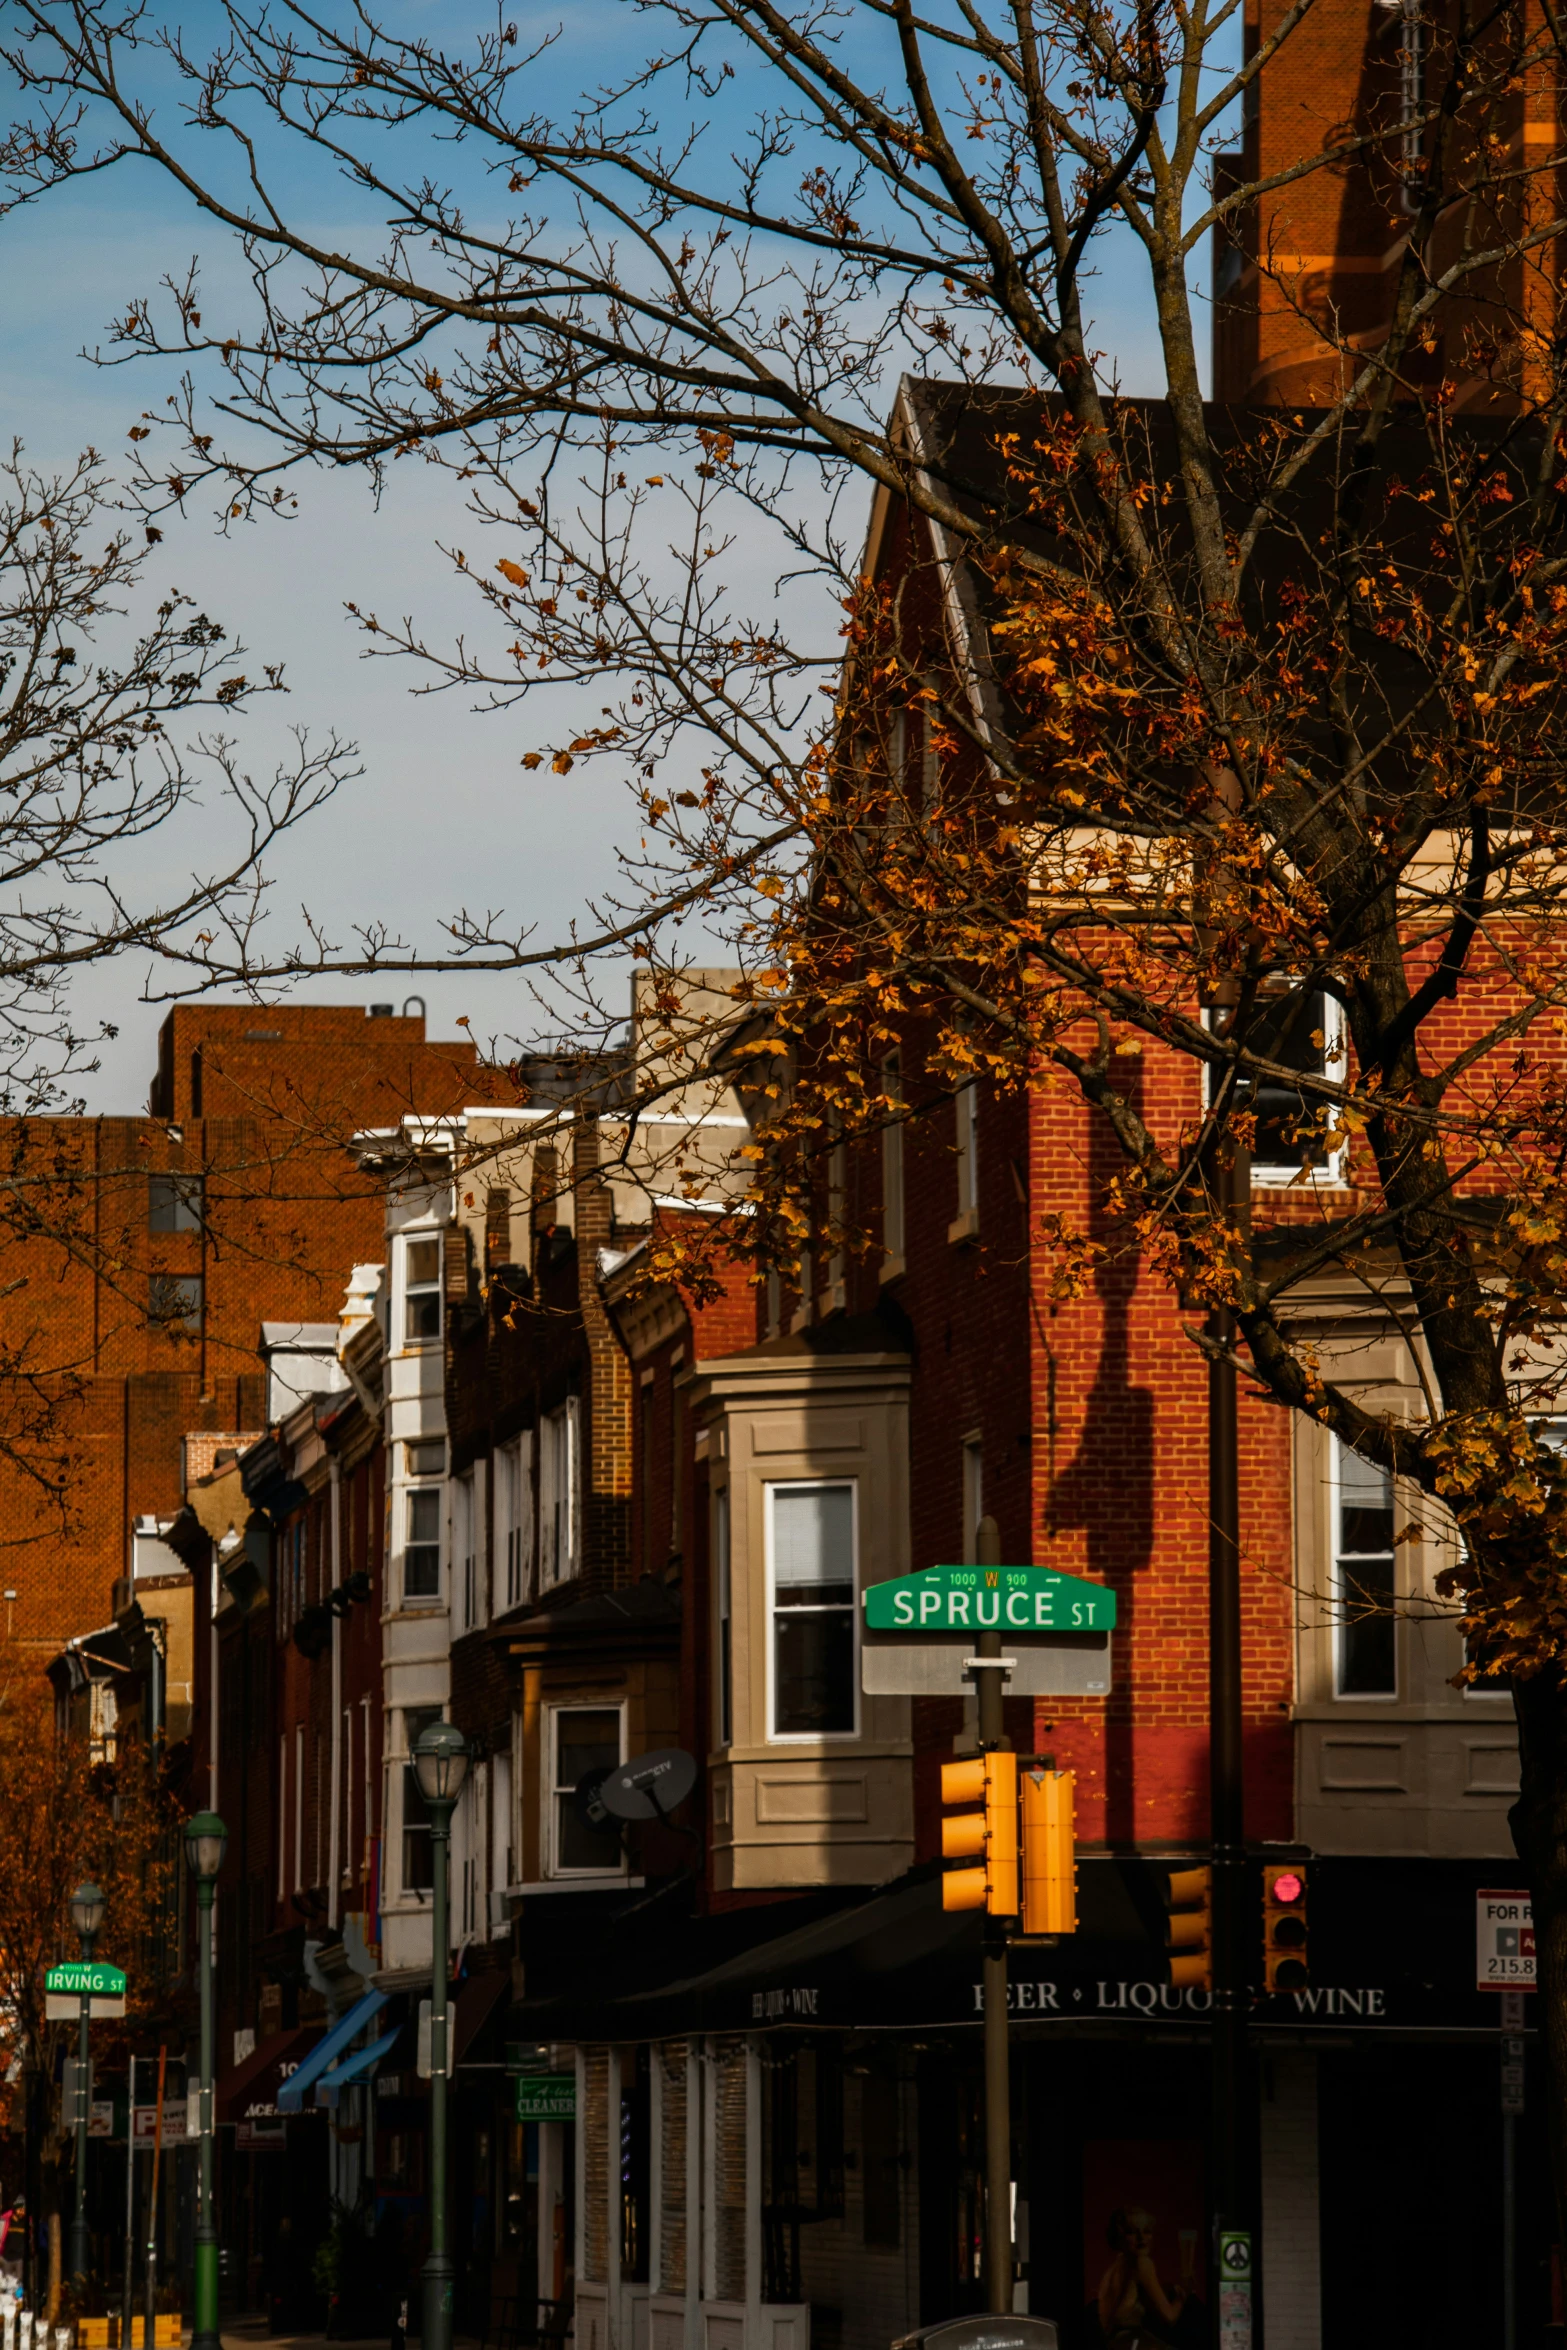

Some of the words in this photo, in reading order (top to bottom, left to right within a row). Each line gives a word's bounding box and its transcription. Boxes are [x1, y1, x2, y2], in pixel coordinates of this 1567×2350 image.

[949, 1573, 977, 1586] 1000
[985, 1571, 999, 1588] W
[1006, 1573, 1027, 1586] 900
[893, 1590, 1055, 1626] SPRUCE
[1071, 1602, 1097, 1626] ST
[1487, 1905, 1519, 1920] FOR
[83, 1964, 92, 1973] W
[48, 1972, 105, 1991] IRVING
[110, 1979, 123, 1991] ST
[792, 1987, 820, 2016] WINE
[1292, 1987, 1387, 2016] WINE
[243, 2102, 275, 2118] ACE
[517, 2098, 576, 2114] CLEANER
